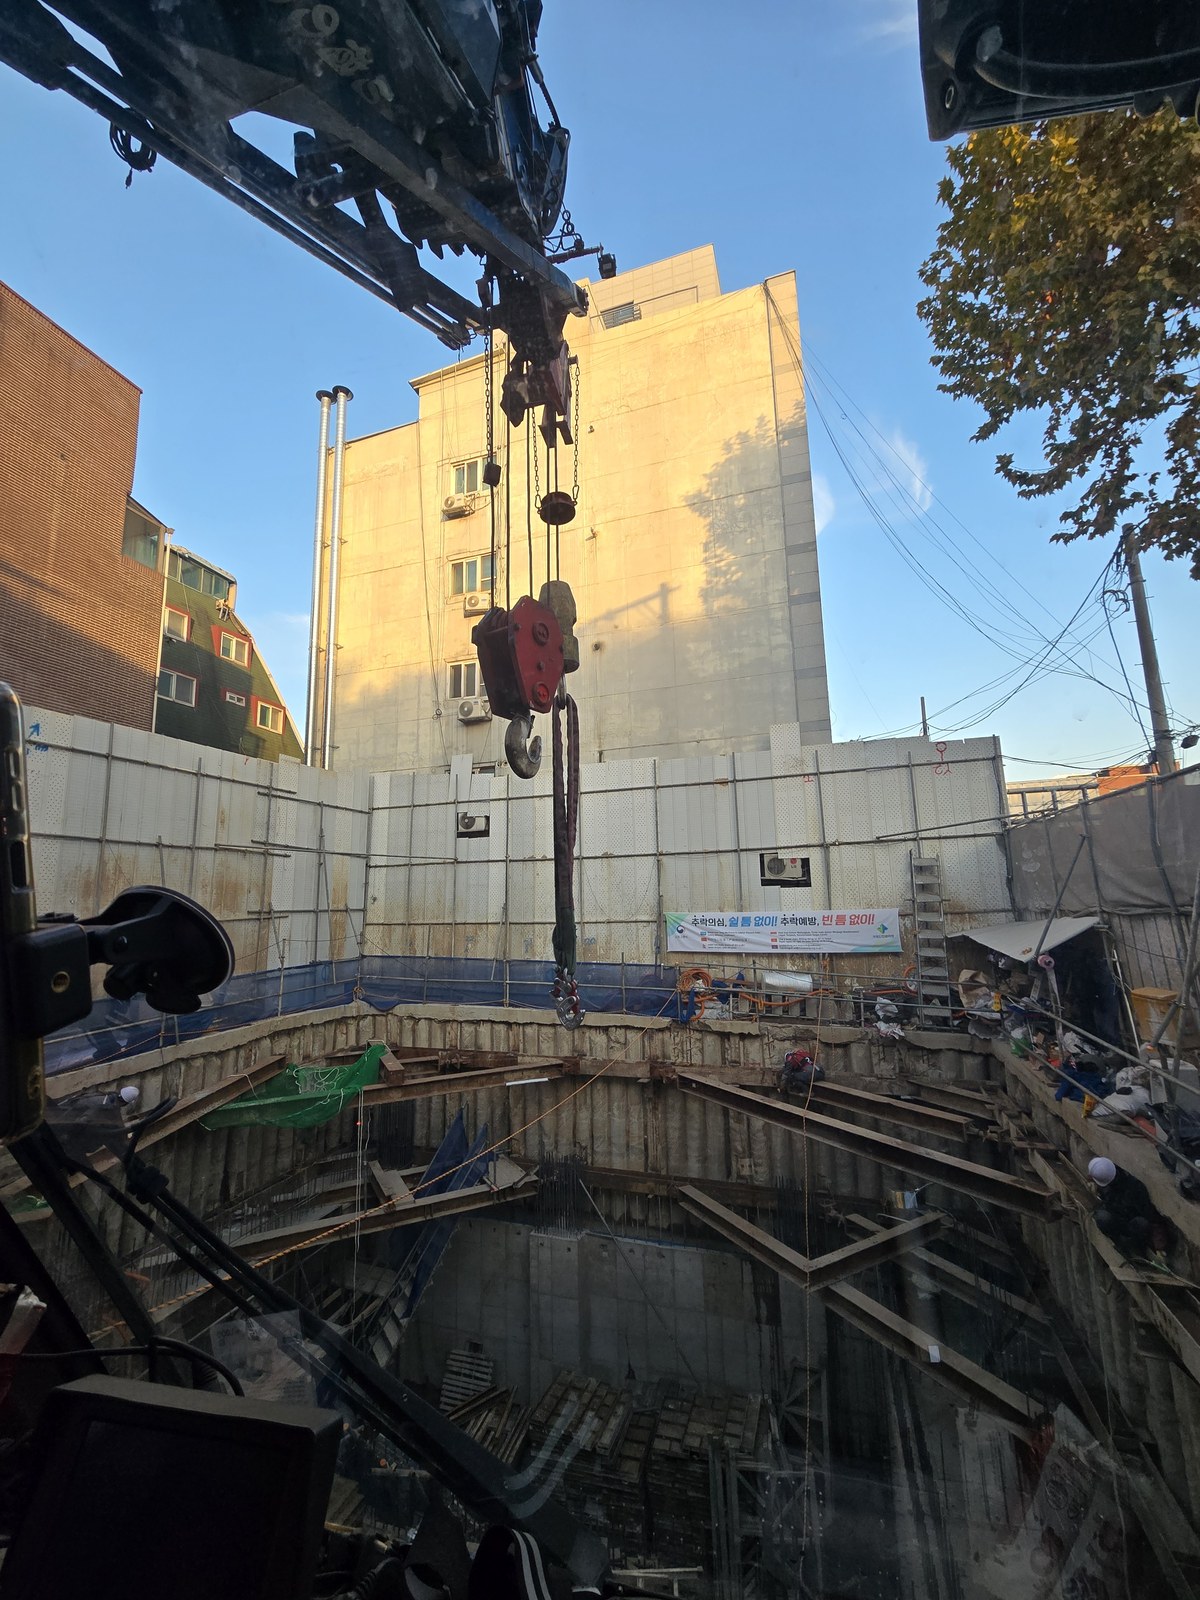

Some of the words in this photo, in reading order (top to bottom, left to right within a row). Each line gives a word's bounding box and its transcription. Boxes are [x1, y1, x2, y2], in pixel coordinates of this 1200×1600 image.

[692, 915, 727, 927] 추락의심,
[754, 915, 778, 927] 없이!
[780, 914, 820, 926] 추락예방,
[822, 914, 833, 926] 빈
[849, 913, 875, 926] 없이!
